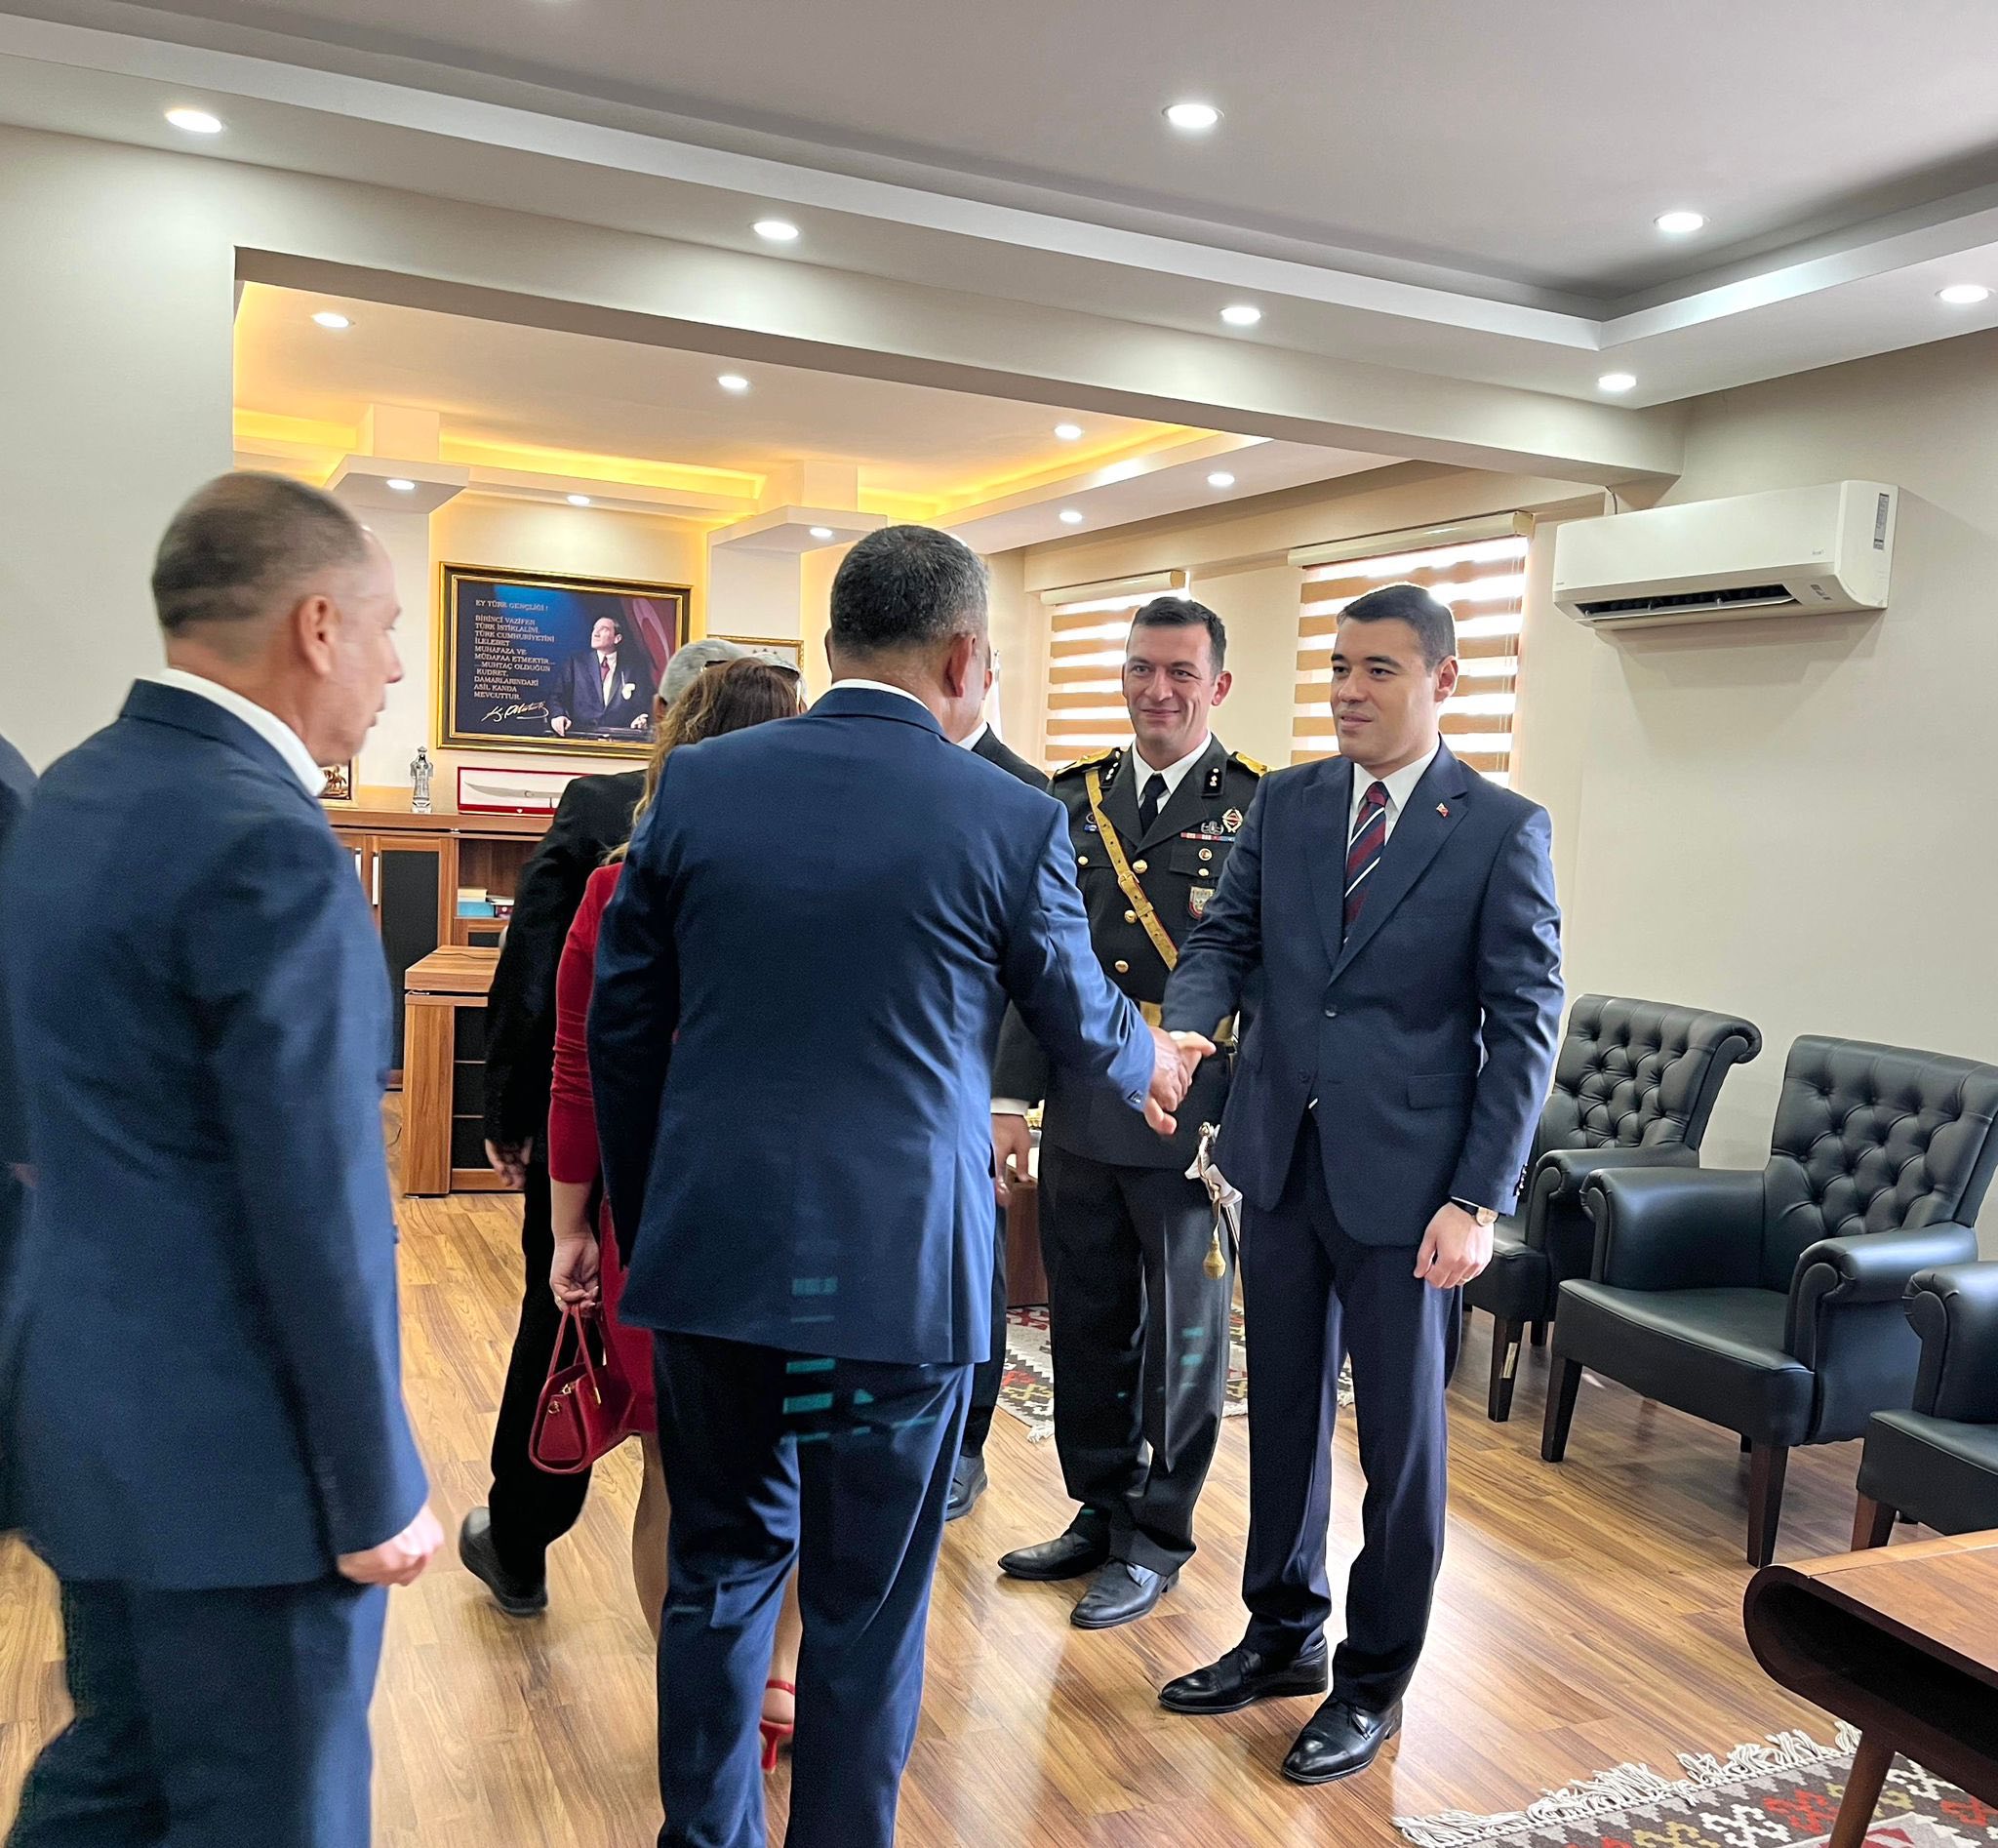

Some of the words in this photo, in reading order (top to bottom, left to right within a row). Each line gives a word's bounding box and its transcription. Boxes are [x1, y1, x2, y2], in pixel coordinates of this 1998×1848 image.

[475, 629, 496, 638] TÜRK
[474, 645, 515, 655] MUHAFAZA
[474, 653, 510, 662] MÜDAFAA
